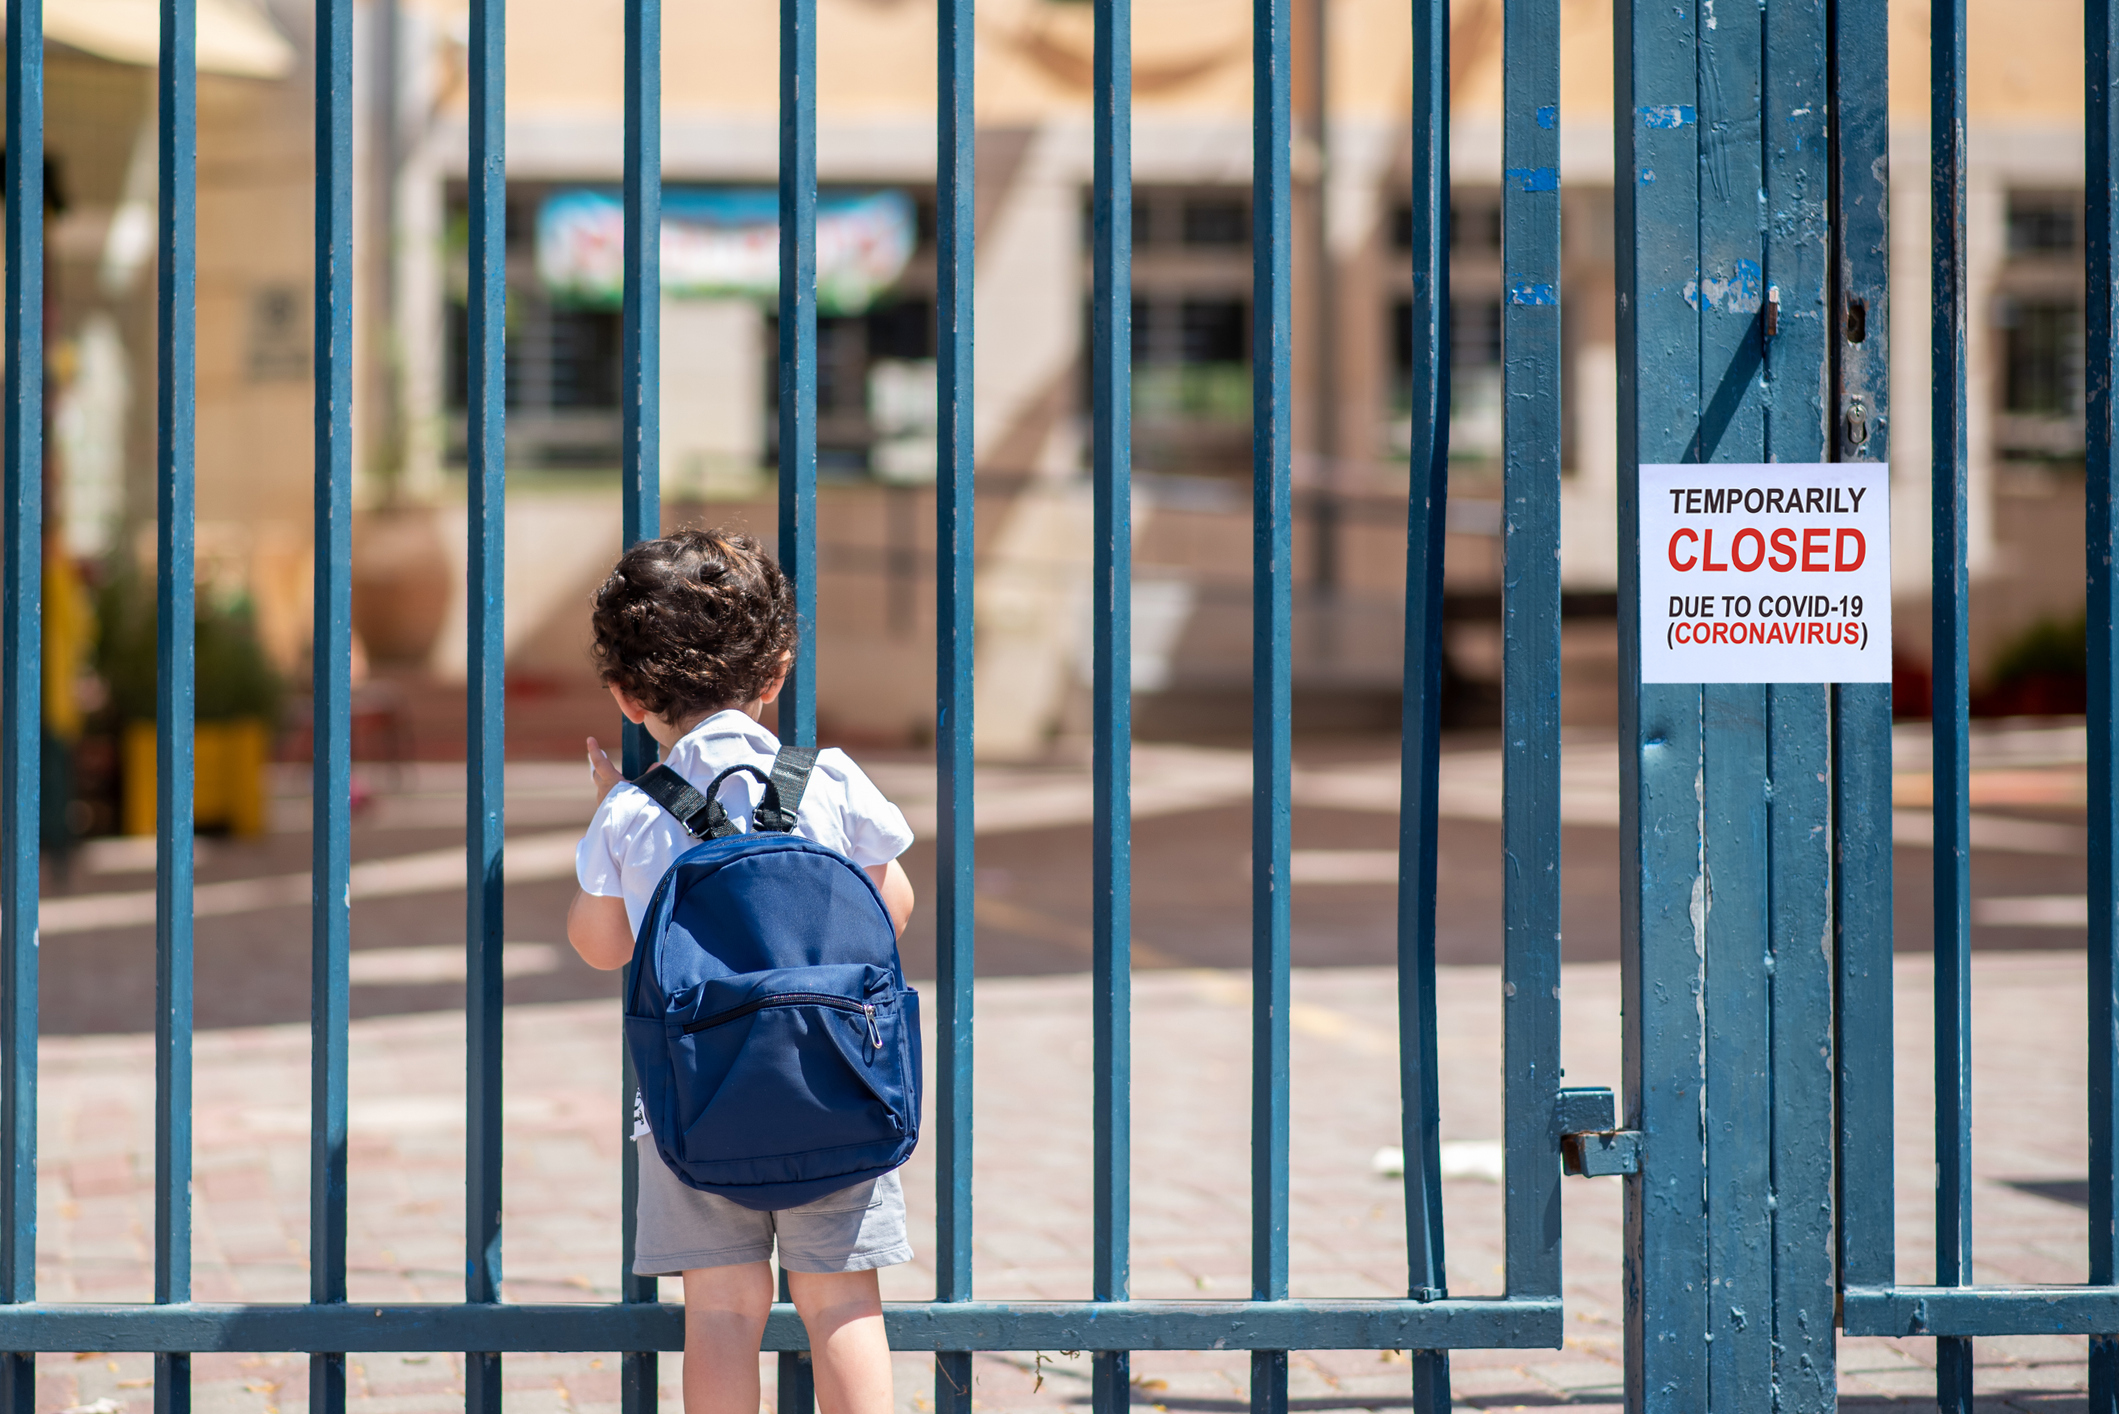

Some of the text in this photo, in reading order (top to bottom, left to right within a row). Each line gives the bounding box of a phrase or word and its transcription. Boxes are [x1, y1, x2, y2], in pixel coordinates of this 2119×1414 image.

[1669, 487, 1867, 514] TEMPORARILY
[1667, 527, 1867, 573] CLOSED
[1668, 595, 1864, 618] DUE TO COVID-19
[1667, 621, 1868, 651] (CORONAVIRUS)
